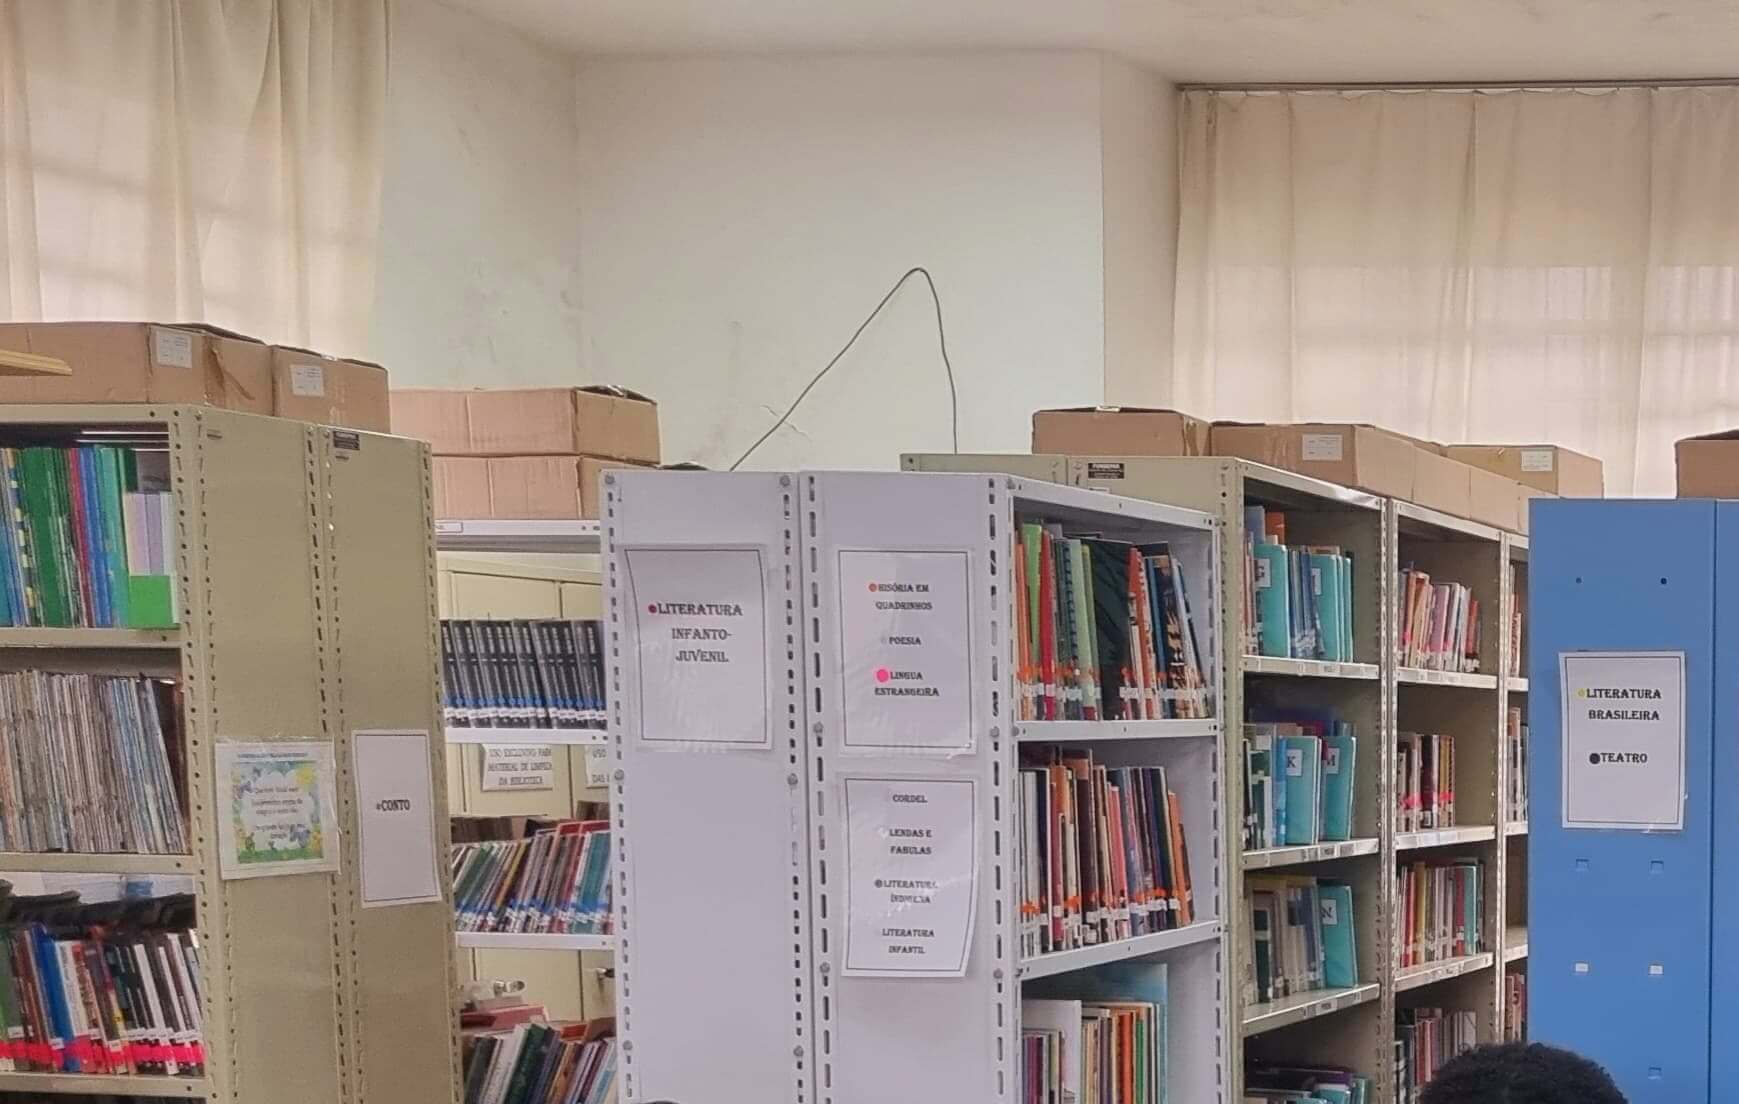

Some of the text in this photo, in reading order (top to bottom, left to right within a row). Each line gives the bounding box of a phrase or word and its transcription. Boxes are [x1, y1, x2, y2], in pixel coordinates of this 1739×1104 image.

[915, 584, 930, 593] EM
[656, 602, 743, 617] LITERATURA
[671, 627, 732, 641] INFANTO-
[888, 636, 922, 646] POESIA
[675, 648, 730, 663] JUVENIL
[874, 687, 940, 697] ESTRANGEIRA
[1586, 688, 1662, 700] LITERATURA
[1588, 709, 1660, 721] BRASILEIRA
[1599, 752, 1648, 764] TEATRO
[891, 793, 929, 804] CORDEL
[381, 799, 411, 811] CONTO
[889, 828, 932, 838] LENDAS E
[881, 928, 935, 938] LITERATURA
[888, 945, 926, 955] INFANTIL
